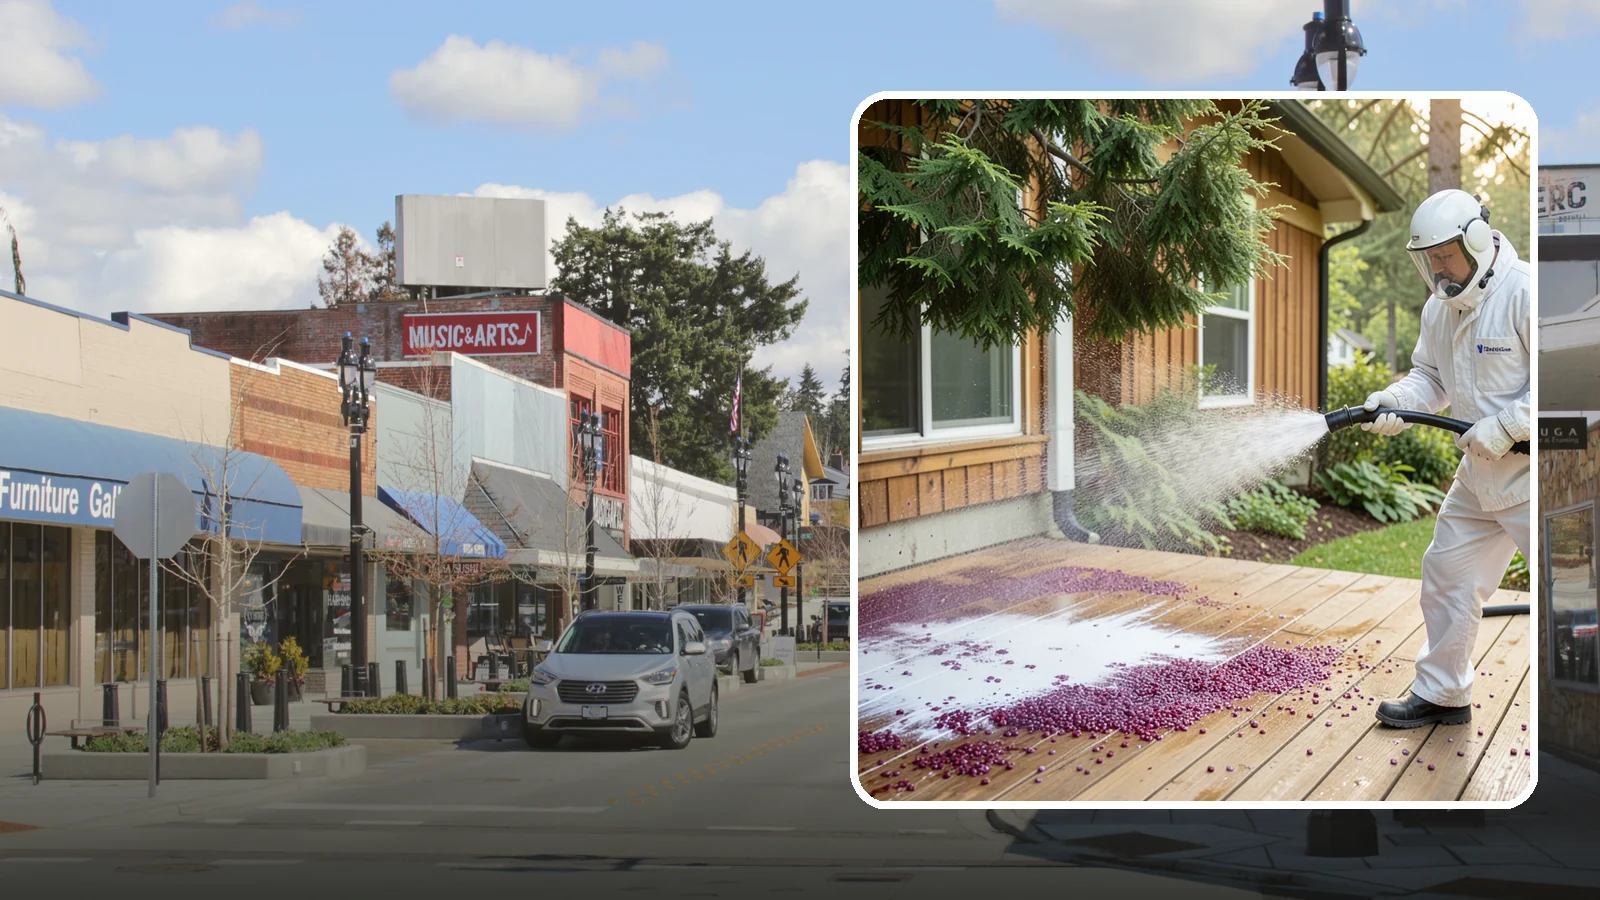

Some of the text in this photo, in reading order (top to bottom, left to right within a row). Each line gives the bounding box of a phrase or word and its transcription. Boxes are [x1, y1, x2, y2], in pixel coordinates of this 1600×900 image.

[409, 323, 519, 348] MUSIC&ARTS
[1540, 428, 1577, 436] UGA
[0, 471, 79, 515] Furniture
[453, 563, 479, 574] SUSHI
